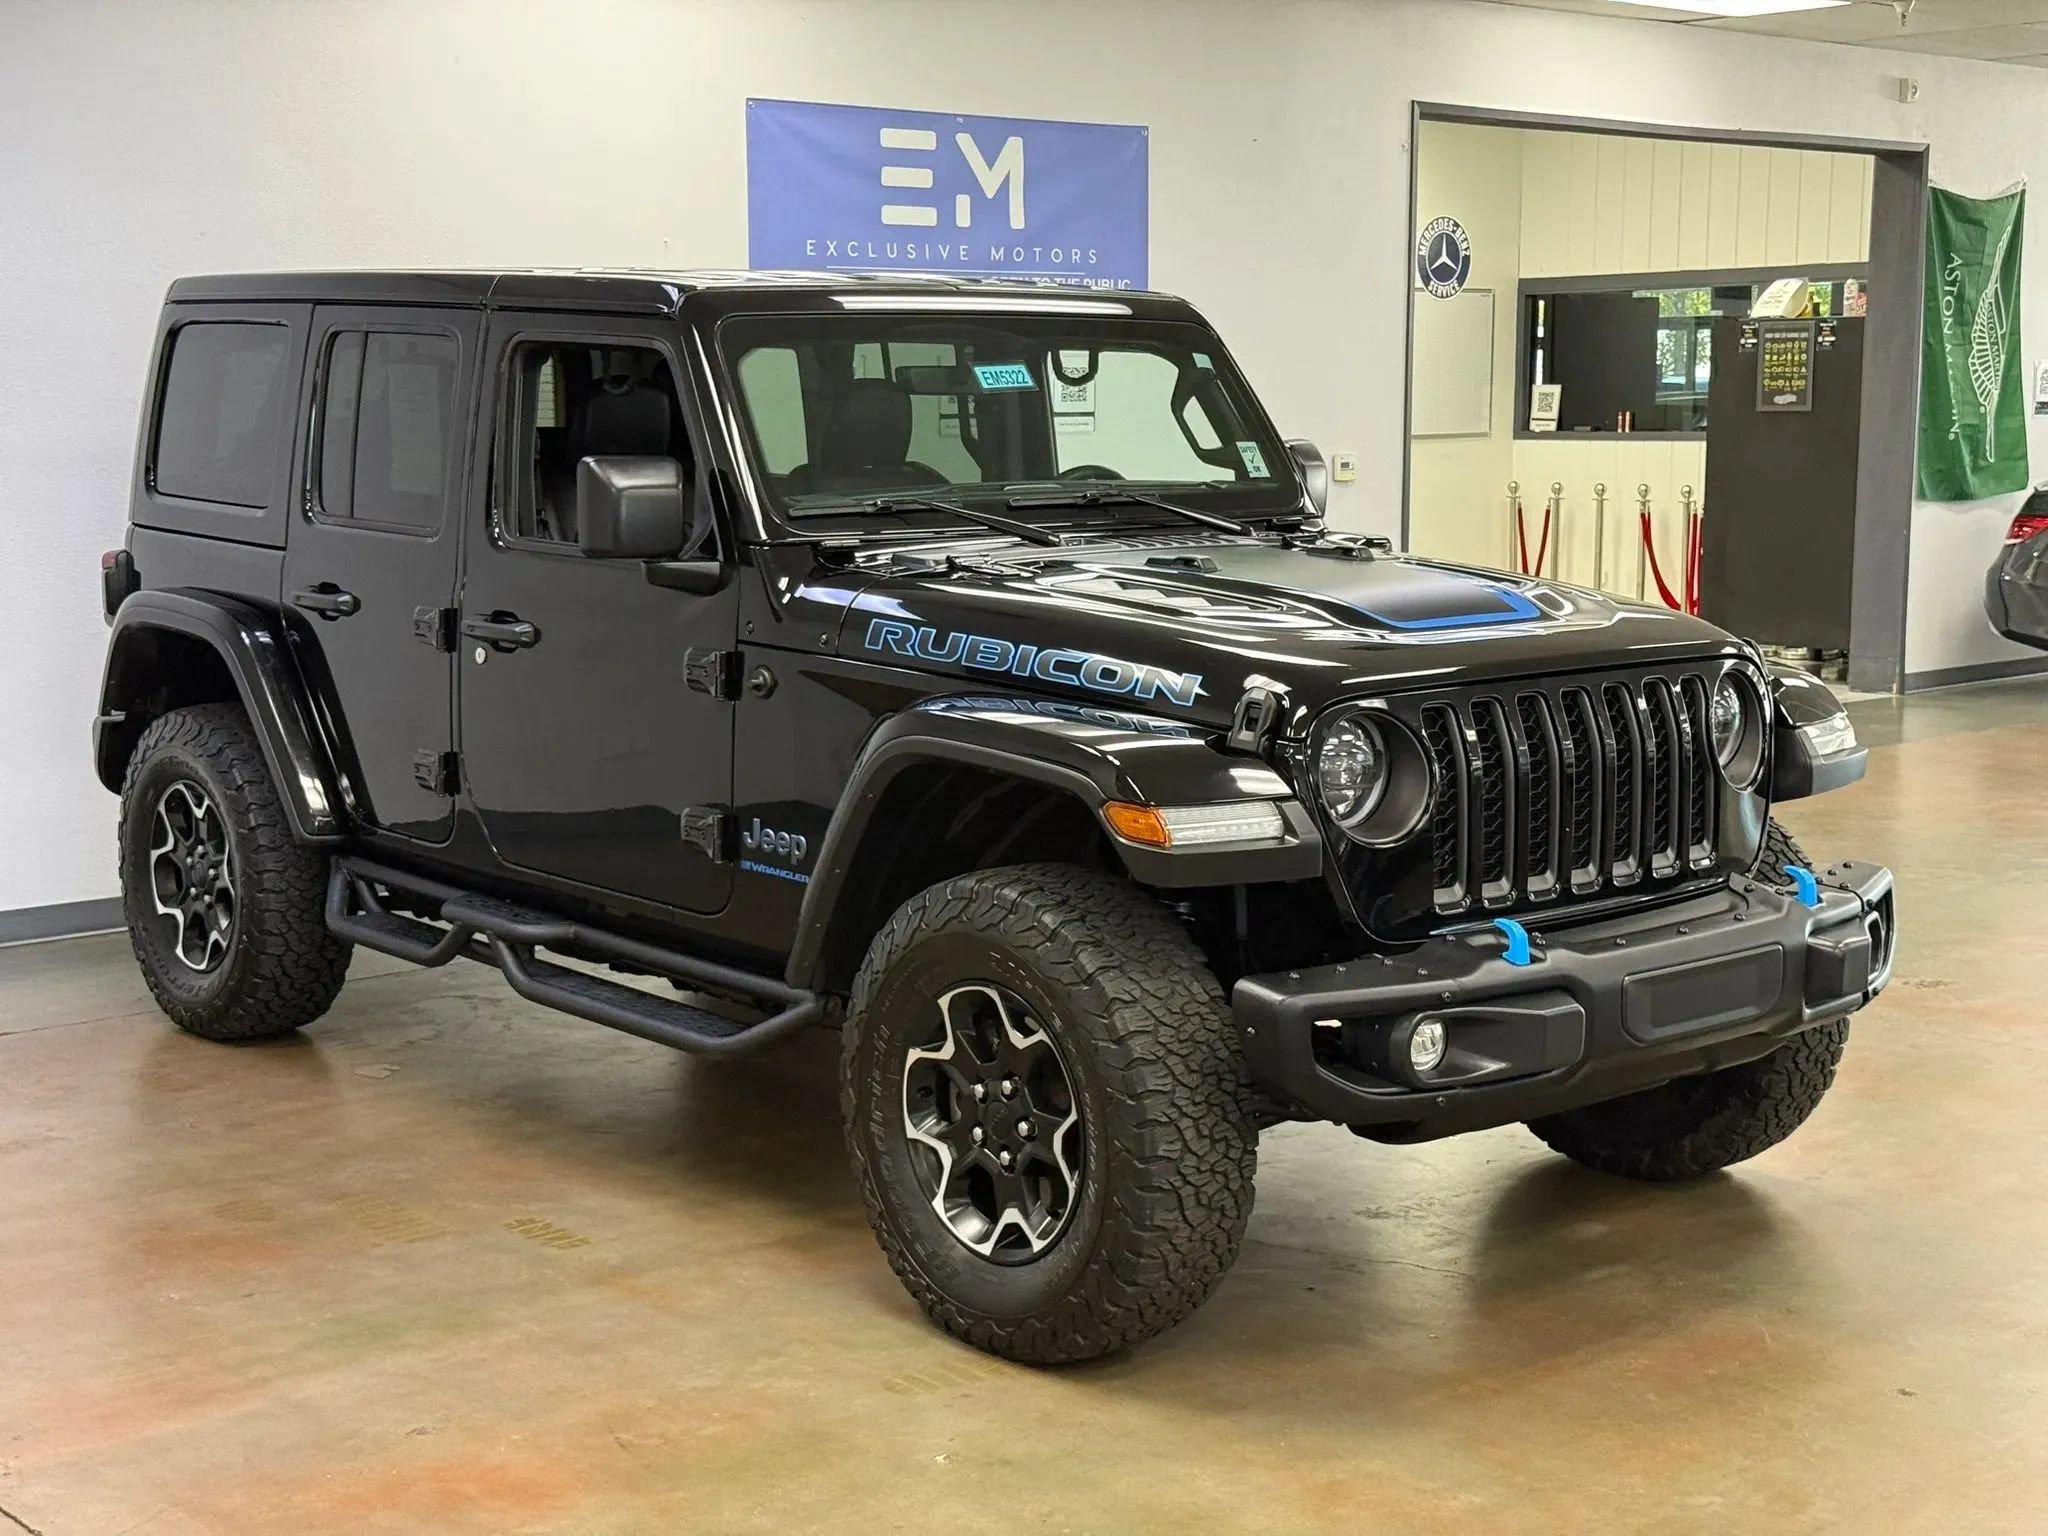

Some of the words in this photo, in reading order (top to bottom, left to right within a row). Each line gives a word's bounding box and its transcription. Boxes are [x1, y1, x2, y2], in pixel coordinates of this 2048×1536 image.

[880, 127, 1025, 230] EM
[806, 239, 970, 261] EXCLUSIVE
[990, 247, 1098, 265] MOTORS
[1418, 218, 1470, 256] MERCEDES-BENZ
[1428, 280, 1460, 298] SERVICE
[1943, 252, 1963, 335] ASTON
[981, 369, 1030, 386] EM5322
[865, 618, 1204, 707] RUBICON
[743, 817, 808, 867] Jeep
[751, 861, 810, 884] WRANGLER
